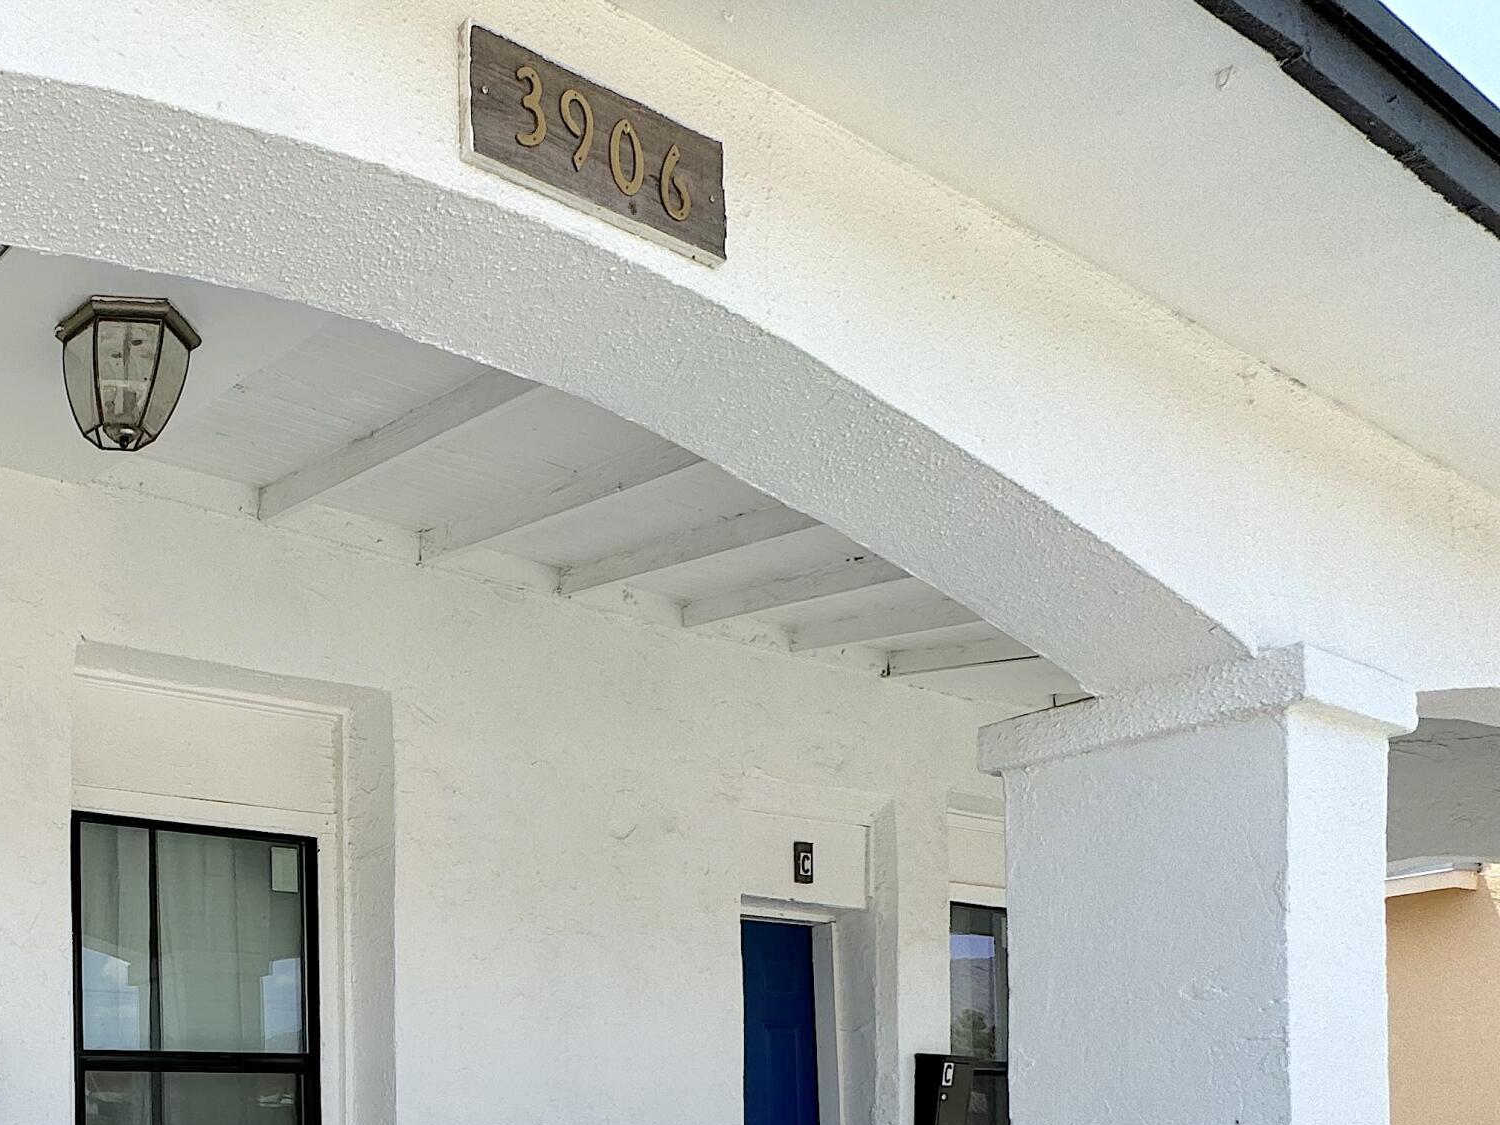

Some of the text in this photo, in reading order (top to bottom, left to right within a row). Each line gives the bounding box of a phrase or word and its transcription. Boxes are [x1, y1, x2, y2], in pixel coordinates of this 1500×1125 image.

[515, 66, 692, 222] 3906
[801, 854, 811, 874] C
[944, 1064, 953, 1084] C
